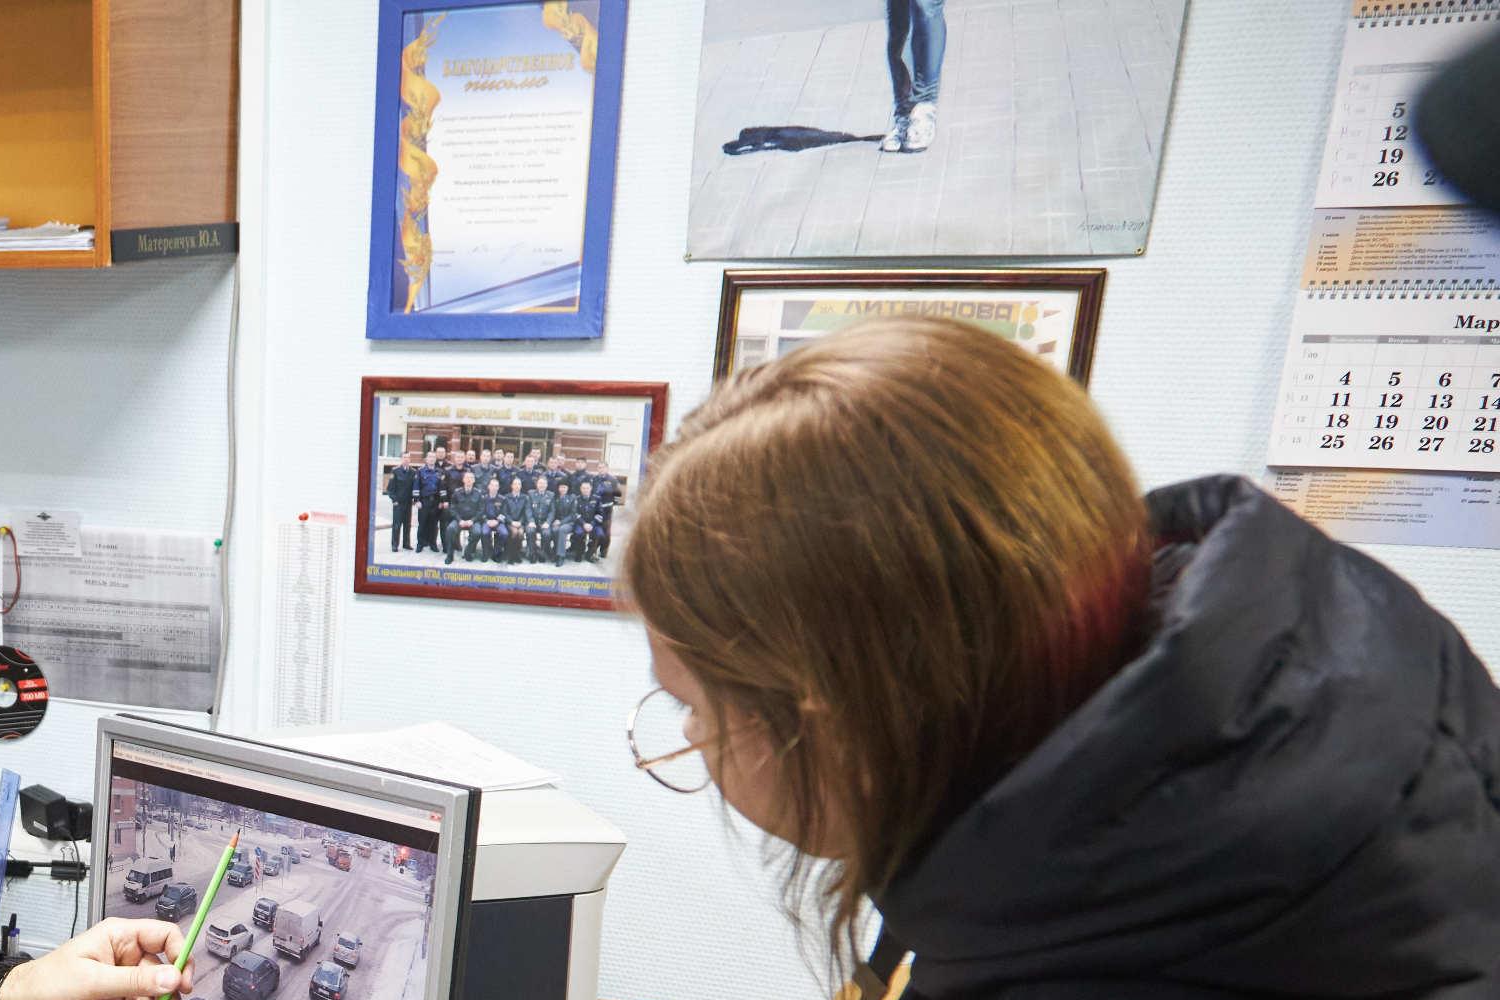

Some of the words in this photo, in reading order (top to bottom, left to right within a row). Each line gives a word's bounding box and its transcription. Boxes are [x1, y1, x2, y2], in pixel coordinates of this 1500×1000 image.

[1392, 102, 1406, 119] 5
[1382, 125, 1409, 142] 12
[1378, 148, 1404, 164] 19
[1372, 171, 1399, 187] 26
[1339, 371, 1351, 386] 4
[1388, 371, 1401, 388] 5
[1438, 372, 1452, 388] 6
[1491, 373, 1500, 388] 7
[1331, 392, 1351, 407] 11
[1379, 393, 1404, 408] 12
[1427, 393, 1453, 409] 13
[1479, 395, 1500, 410] 14
[1325, 413, 1349, 428] 18
[1373, 414, 1399, 429] 19
[1422, 415, 1449, 431] 20
[1472, 416, 1497, 432] 21
[1319, 434, 1346, 449] 25
[1368, 435, 1395, 450] 26
[1417, 437, 1445, 452] 27
[1467, 438, 1495, 453] 28
